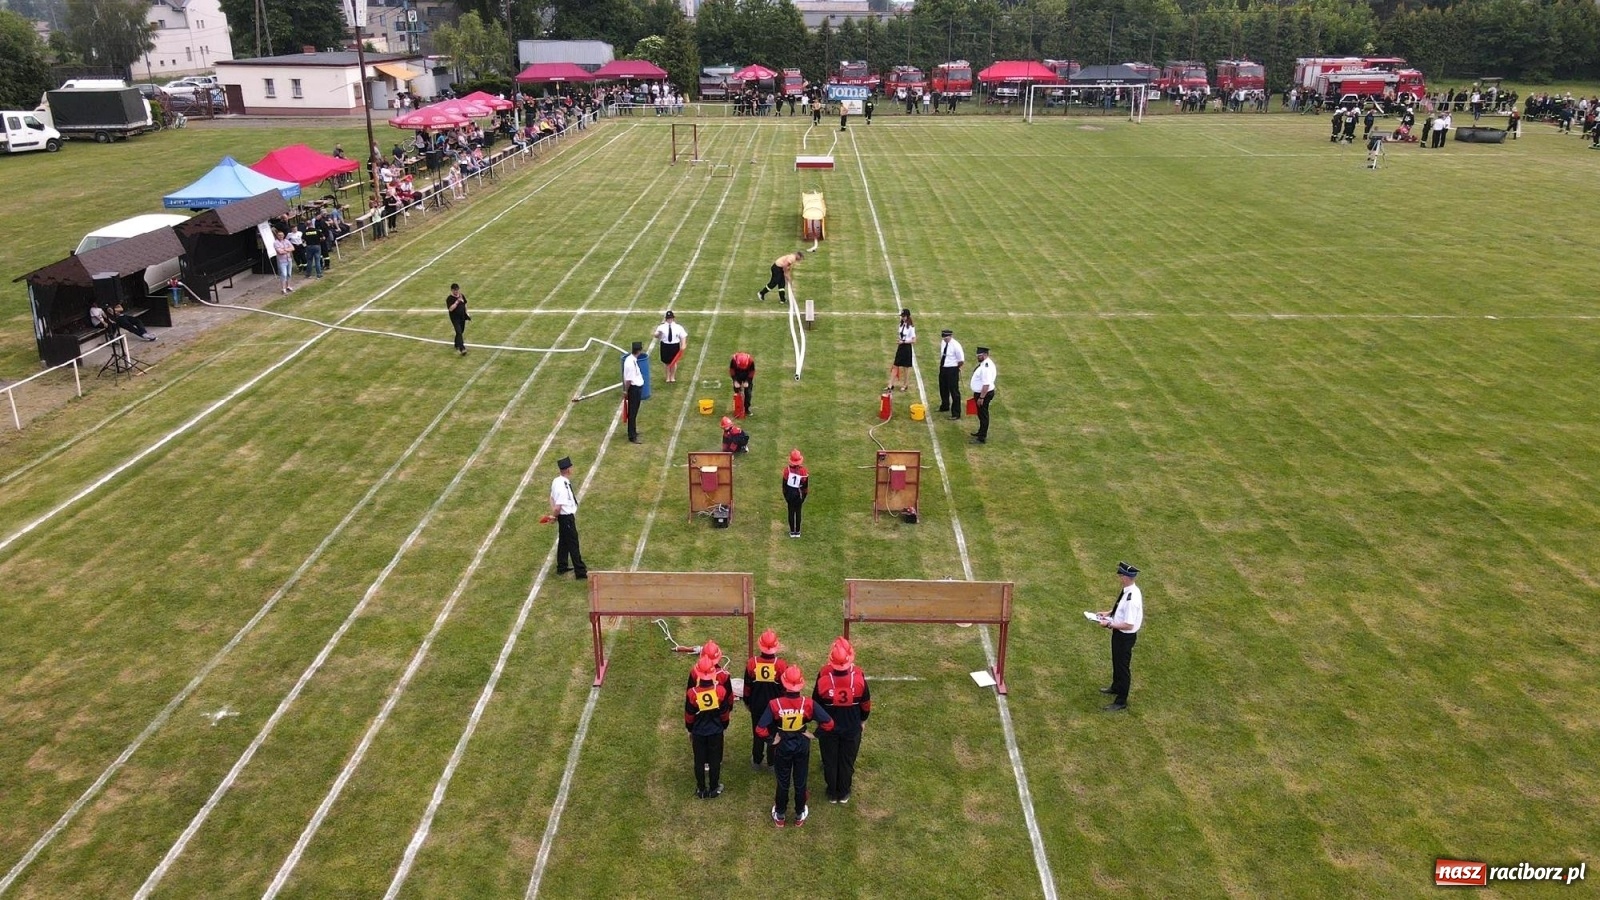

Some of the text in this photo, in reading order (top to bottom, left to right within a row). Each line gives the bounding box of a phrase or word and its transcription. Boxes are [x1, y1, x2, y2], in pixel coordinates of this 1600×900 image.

[792, 475, 797, 485] 1
[760, 666, 770, 679] 6
[702, 692, 714, 707] 9
[838, 690, 848, 703] 3
[786, 716, 797, 729] 7
